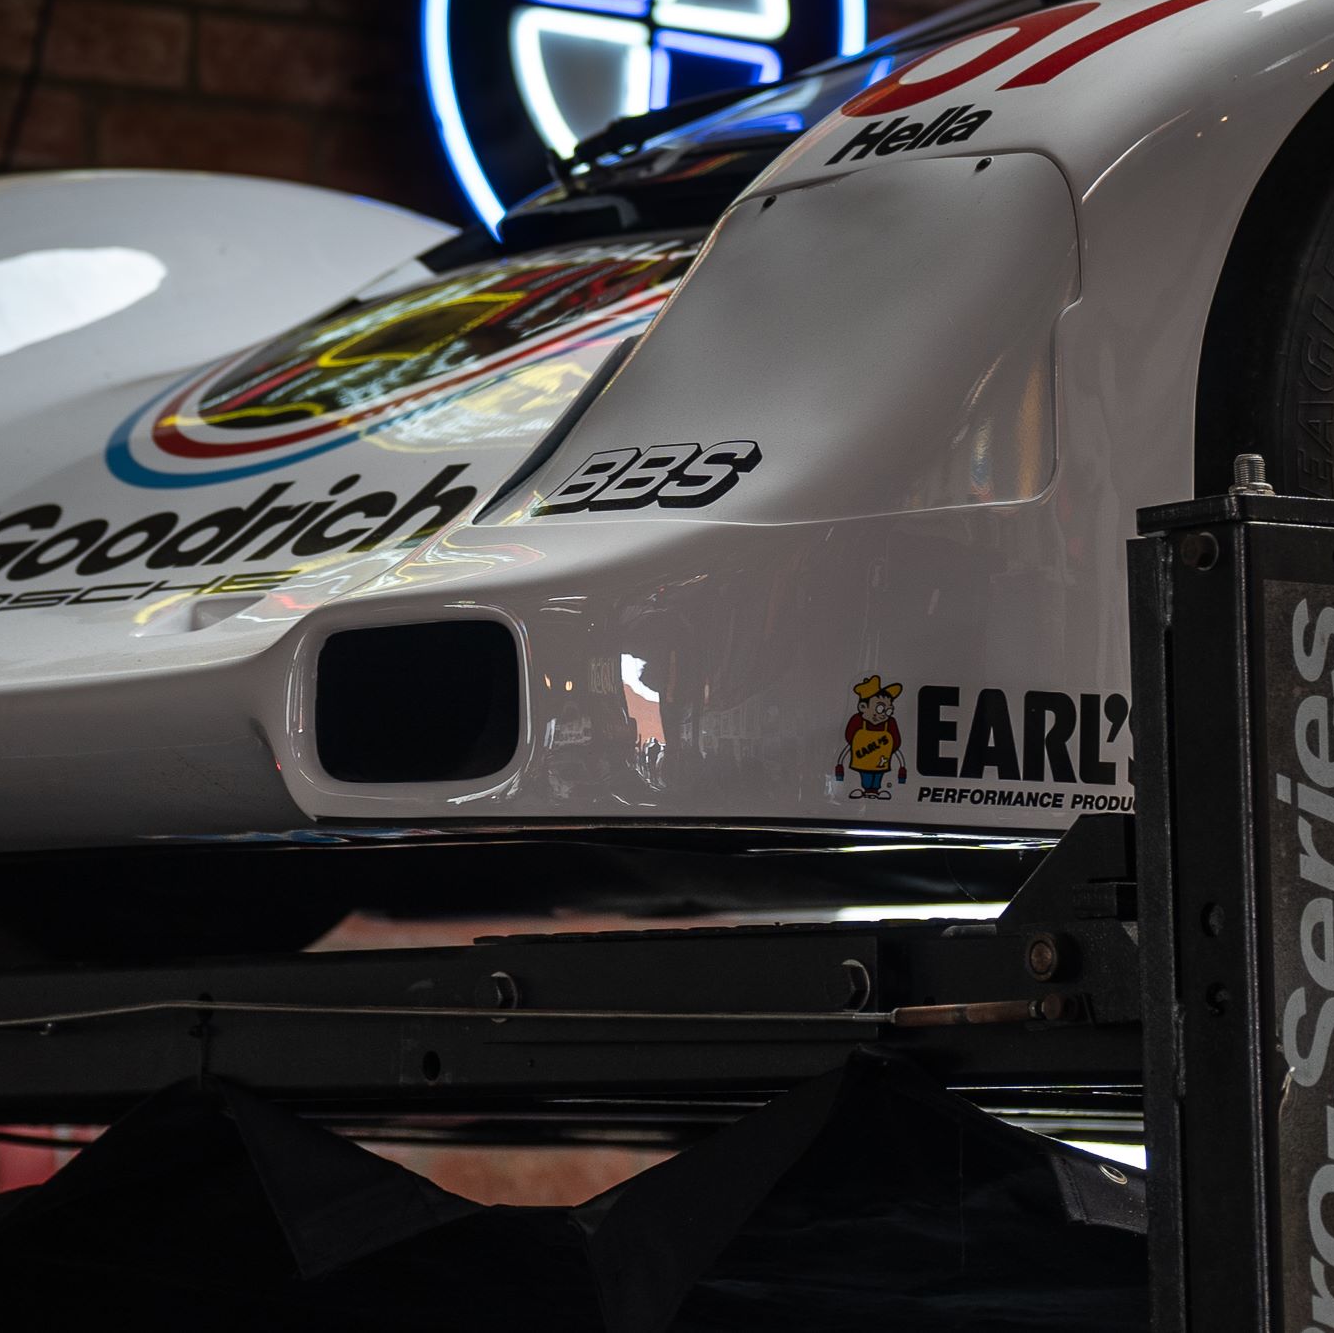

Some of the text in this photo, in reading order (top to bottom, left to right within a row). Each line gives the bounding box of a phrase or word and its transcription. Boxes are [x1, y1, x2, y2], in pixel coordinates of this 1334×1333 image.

[825, 104, 993, 166] Hella
[530, 439, 764, 519] BBS
[855, 734, 889, 759] EARL'S
[917, 685, 1134, 785] EARL'
[917, 786, 1135, 812] PERFORMANCE PRODU
